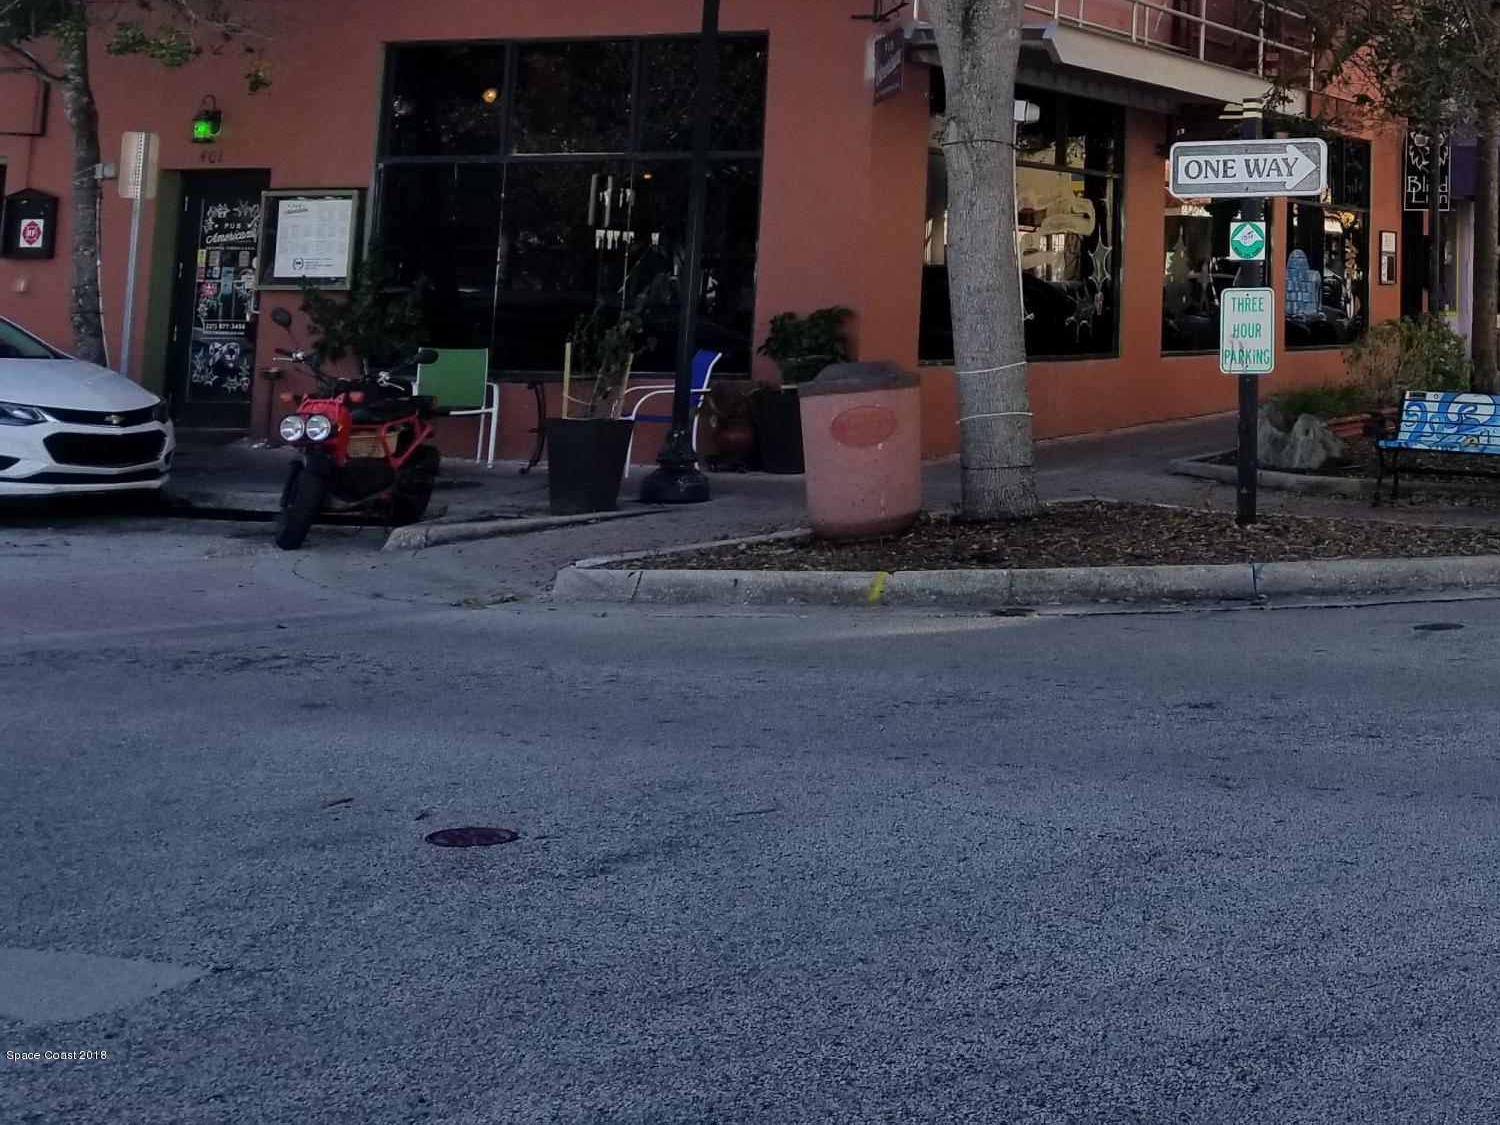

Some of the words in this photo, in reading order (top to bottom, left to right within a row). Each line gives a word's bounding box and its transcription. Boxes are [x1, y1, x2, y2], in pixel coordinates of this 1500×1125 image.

[1184, 159, 1237, 180] ONE
[1245, 157, 1299, 178] WAY
[1407, 175, 1448, 193] Blid
[1411, 186, 1448, 204] Lin
[1231, 296, 1265, 313] THREE
[1233, 322, 1262, 338] HOUR
[1224, 348, 1270, 365] PARKING
